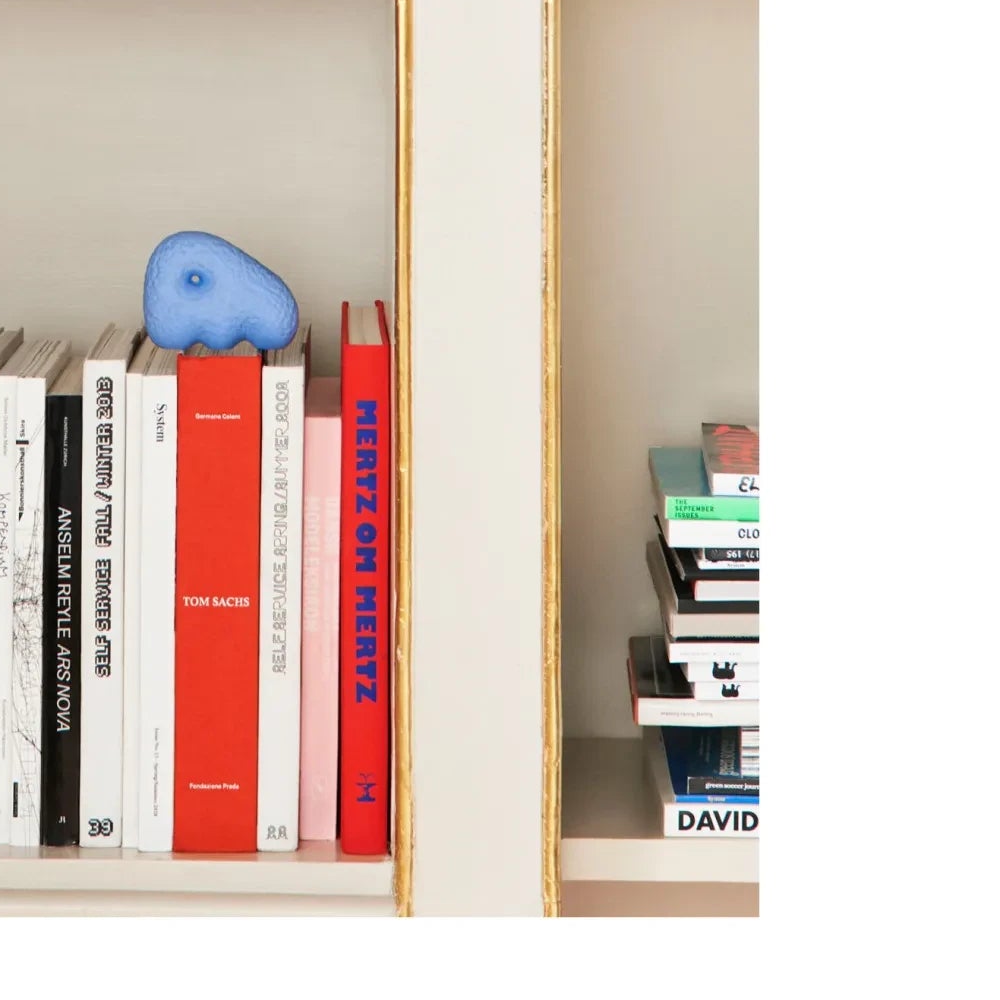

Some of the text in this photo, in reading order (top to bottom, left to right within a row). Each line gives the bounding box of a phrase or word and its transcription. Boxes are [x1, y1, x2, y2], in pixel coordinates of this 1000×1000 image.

[96, 376, 113, 420] 2013
[153, 403, 167, 442] System
[95, 423, 112, 489] WINTER
[95, 504, 112, 548] FALL
[356, 400, 377, 703] MERTZ OM MERTZ
[94, 559, 111, 632] SERVICE
[183, 597, 250, 607] TOM SACHS
[56, 507, 72, 732] ANSELM REYLE ARS NOVA
[94, 635, 111, 678] SELF
[88, 818, 113, 837] 39
[678, 810, 759, 831] DAVID
